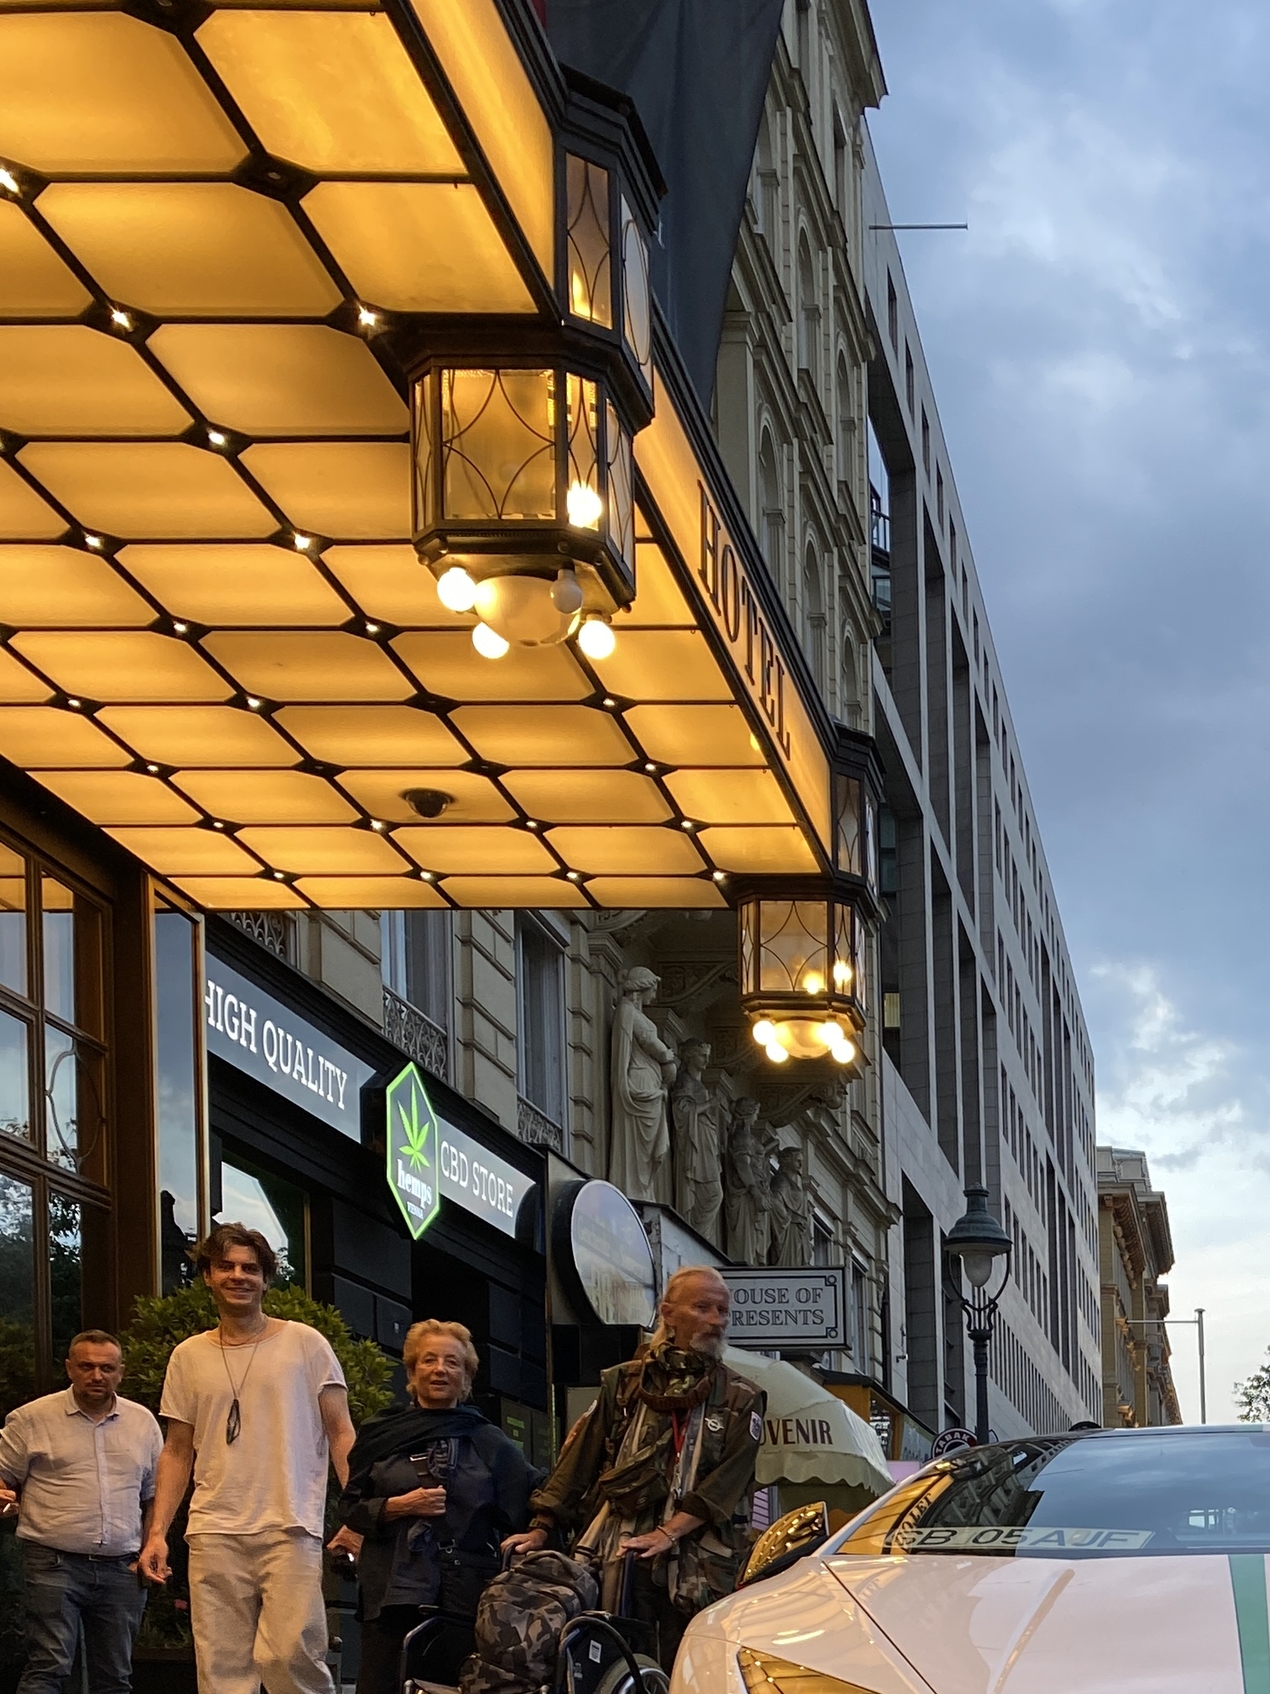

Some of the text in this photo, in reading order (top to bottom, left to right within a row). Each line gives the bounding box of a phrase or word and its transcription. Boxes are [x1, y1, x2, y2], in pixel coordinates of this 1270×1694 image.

[697, 479, 790, 761] HOTEL
[205, 980, 347, 1110] HIGH QUALITY
[397, 1159, 431, 1209] hemps
[440, 1140, 514, 1218] CBD STORE
[731, 1288, 823, 1305] OUSE OF
[729, 1309, 824, 1326] RESENTS
[935, 1431, 970, 1454] TABAK
[972, 1529, 1033, 1545] 05
